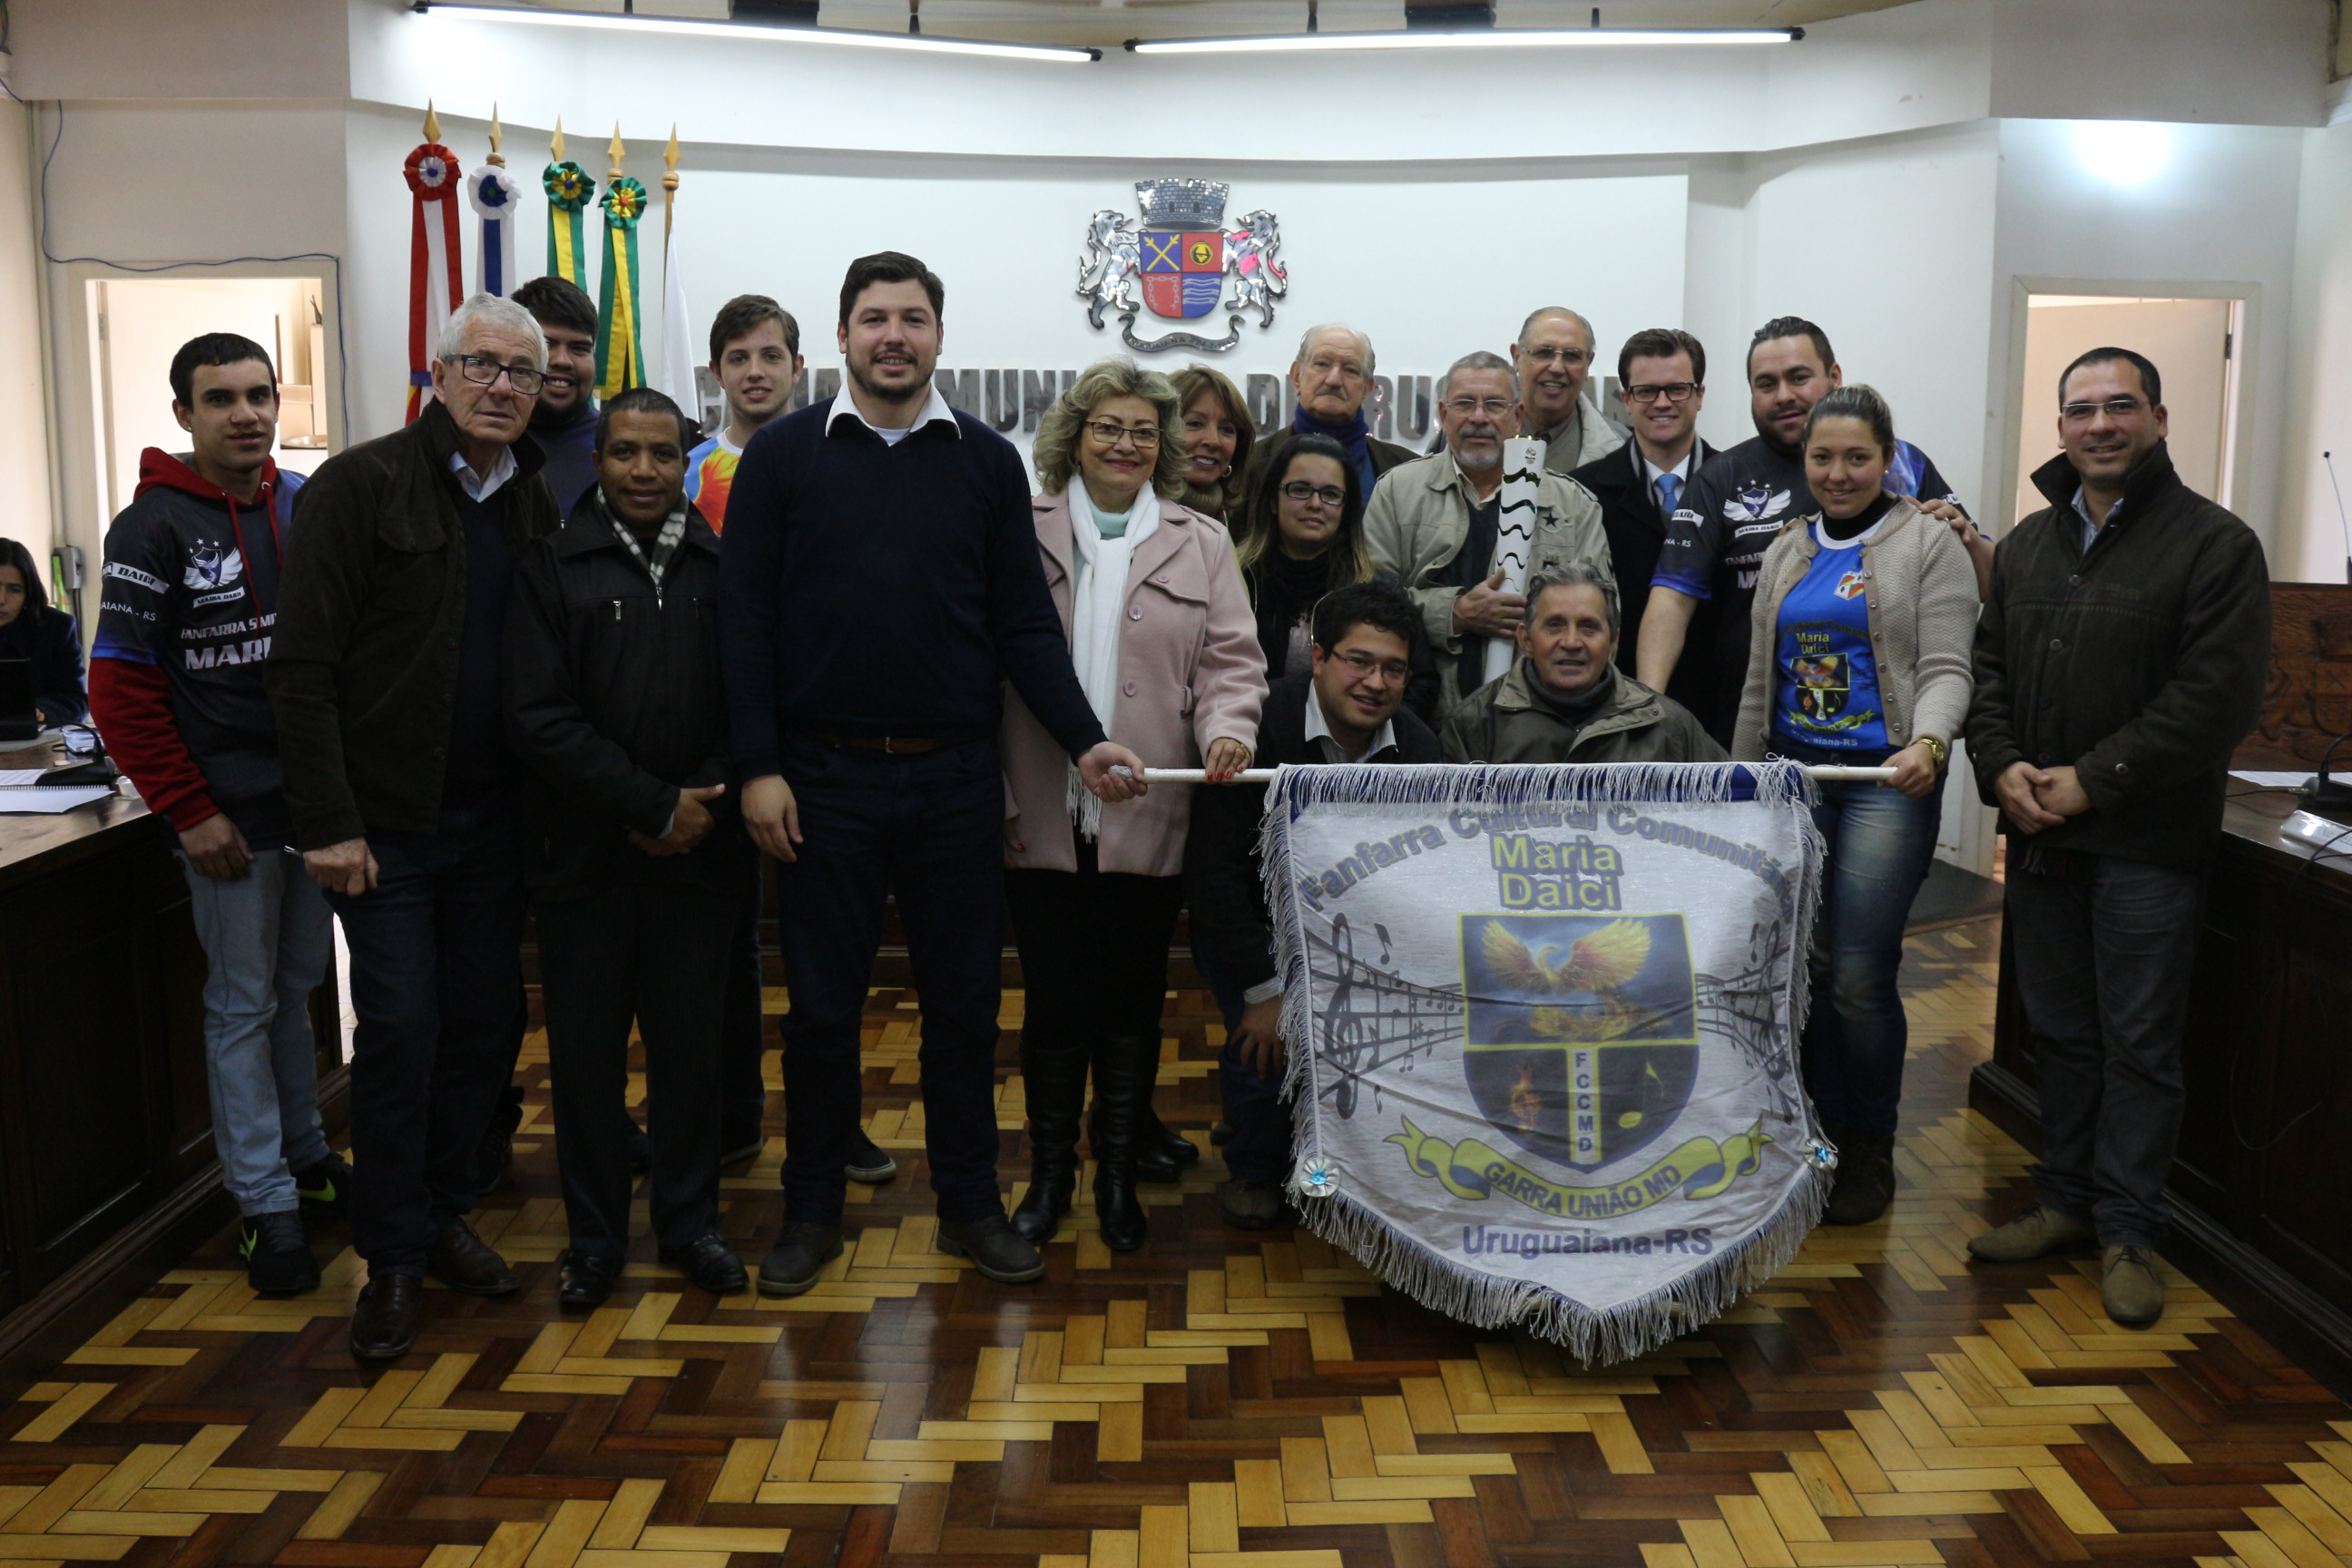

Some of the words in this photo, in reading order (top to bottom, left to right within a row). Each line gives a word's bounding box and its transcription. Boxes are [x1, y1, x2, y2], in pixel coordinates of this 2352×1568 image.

[142, 611, 156, 622] RS
[1796, 632, 1829, 643] Maria
[1800, 643, 1829, 654] Daici
[1298, 823, 1446, 911] Fanfarra
[1491, 835, 1619, 871] Maria
[1500, 873, 1617, 907] Daici
[1484, 1161, 1562, 1214] GARRA
[1568, 1185, 1642, 1217] UNIÃO
[1642, 1164, 1681, 1200] MD
[1463, 1225, 1713, 1259] Uruguaiana-RS
